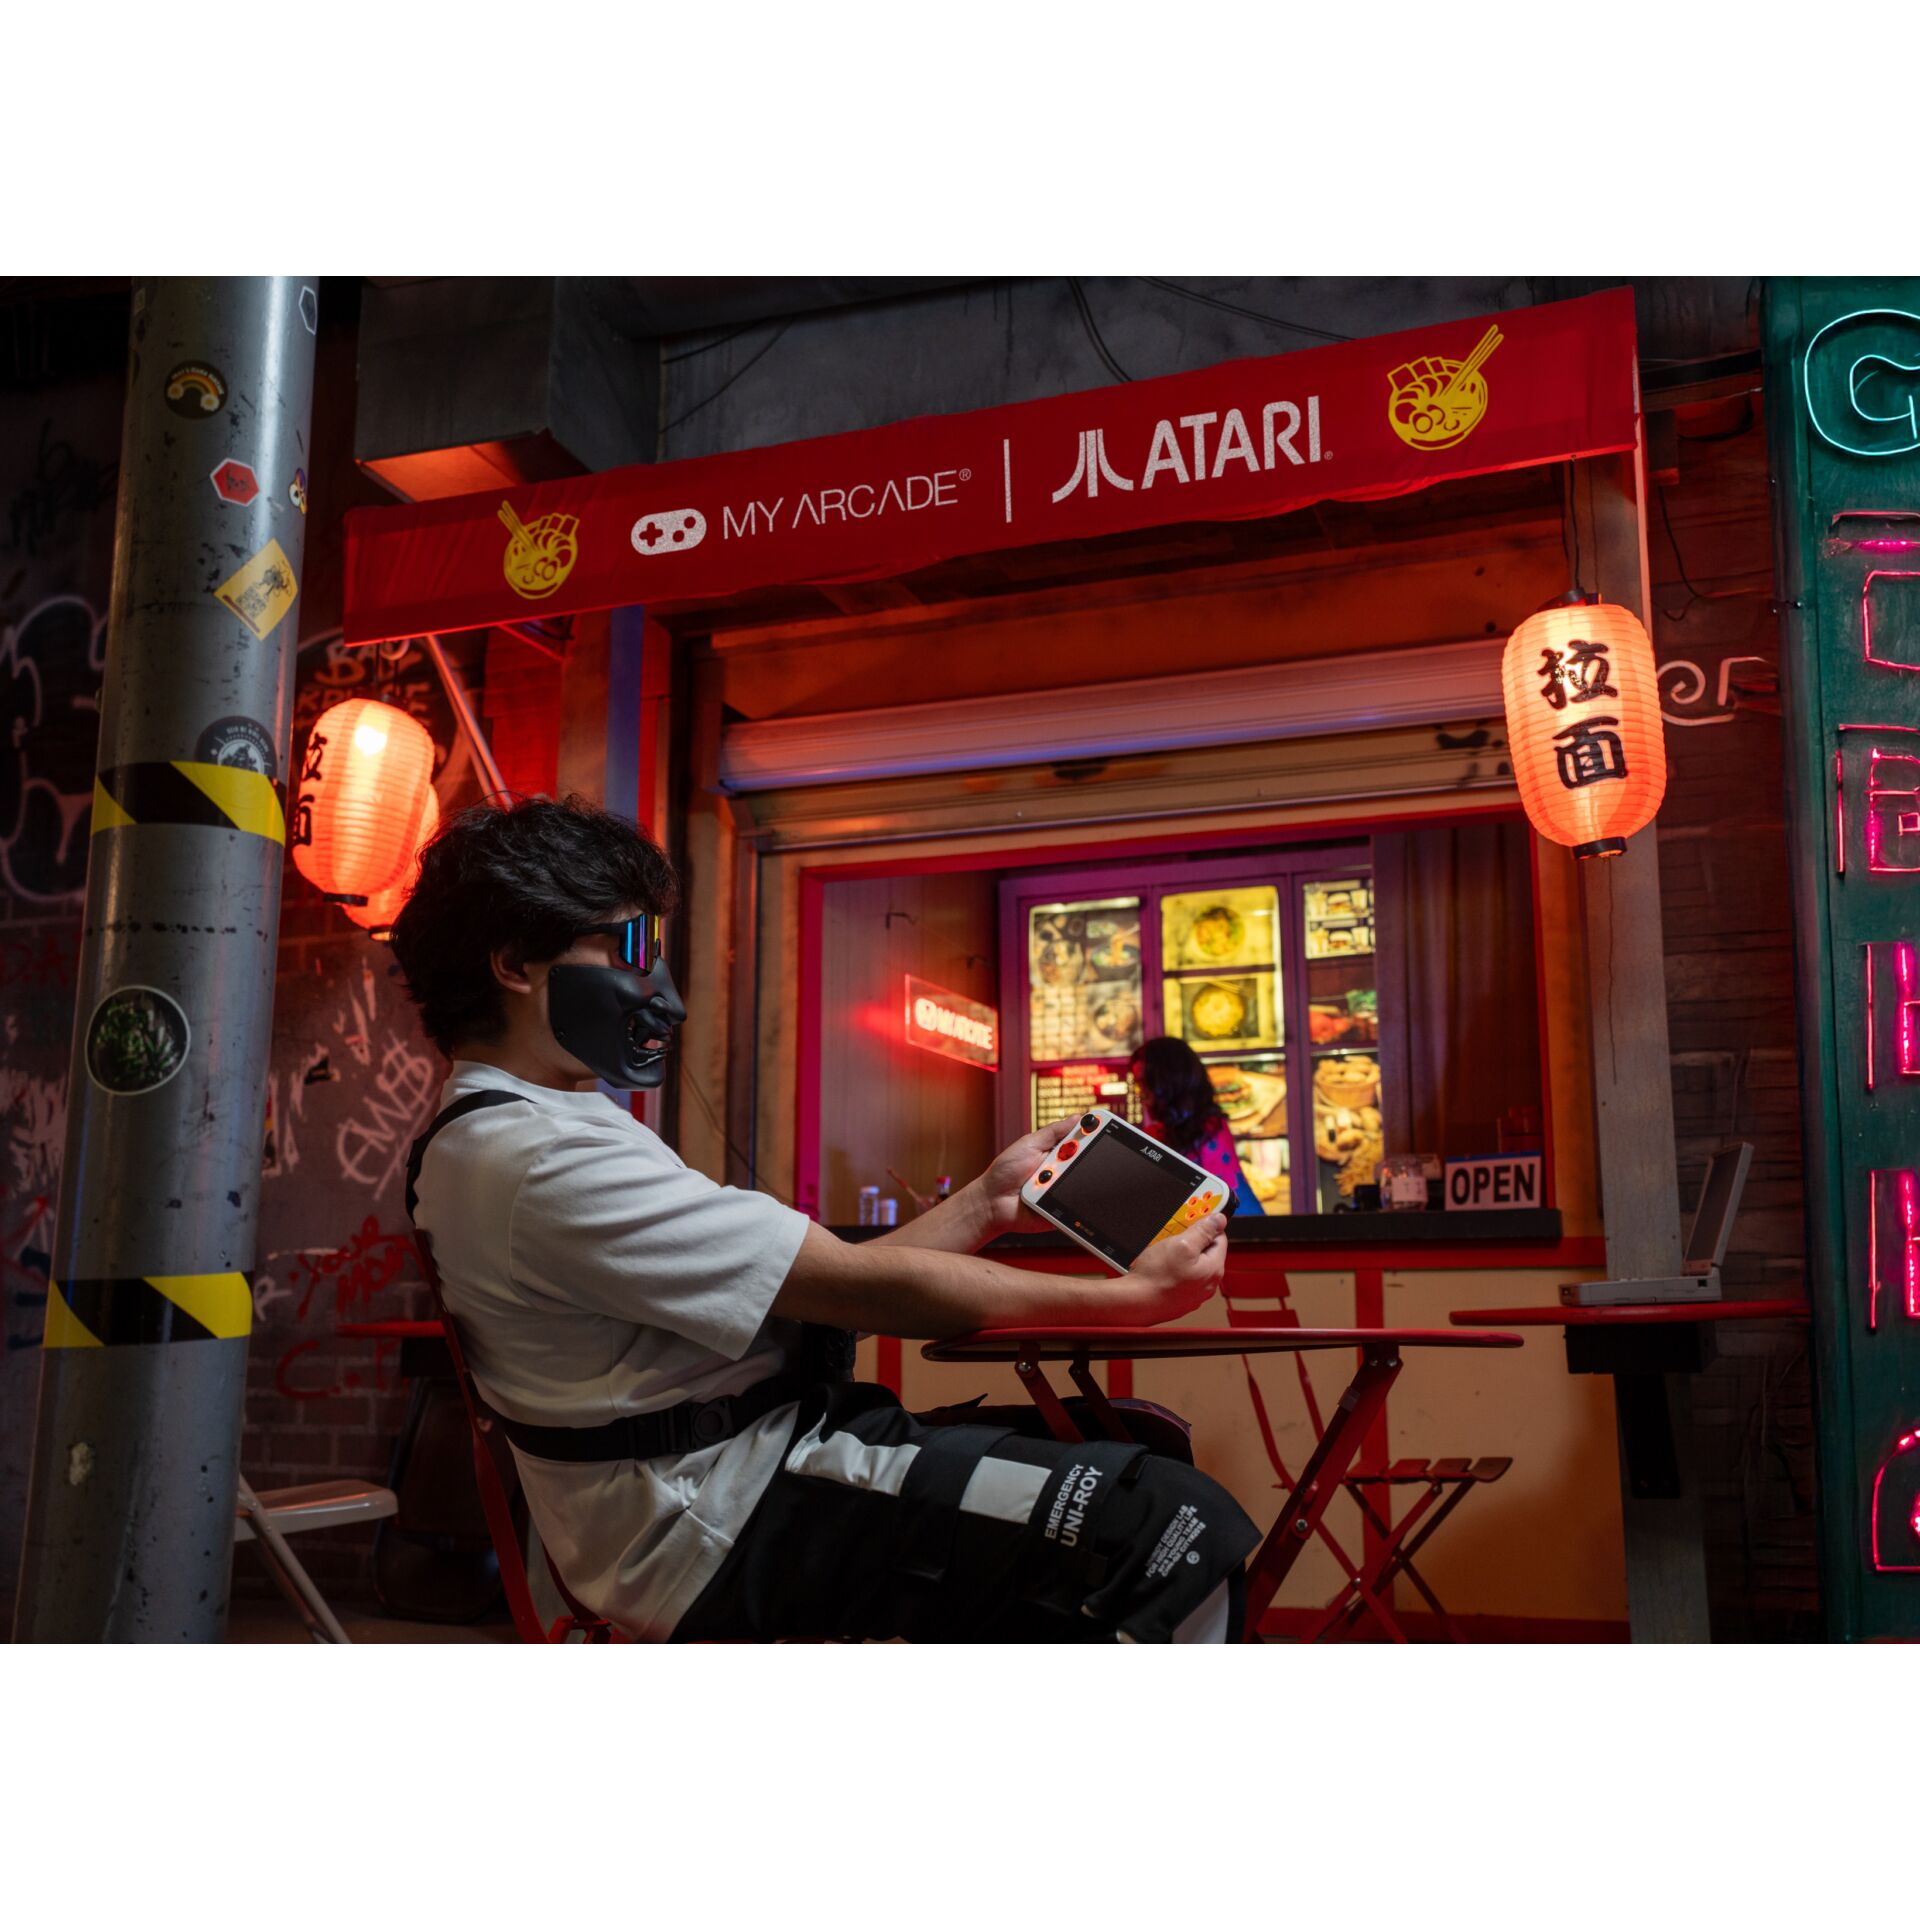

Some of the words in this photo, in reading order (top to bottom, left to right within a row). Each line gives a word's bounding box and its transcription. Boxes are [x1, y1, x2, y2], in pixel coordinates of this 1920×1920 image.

[721, 497, 784, 540] MY
[1450, 1163, 1536, 1205] OPEN
[1045, 1464, 1084, 1540] EMERGENCY
[1060, 1466, 1103, 1547] UNI-ROY
[1175, 1504, 1189, 1520] LAB
[1165, 1518, 1188, 1548] QUALITY
[1183, 1504, 1198, 1522] LIFE
[1182, 1516, 1199, 1537] TEAM
